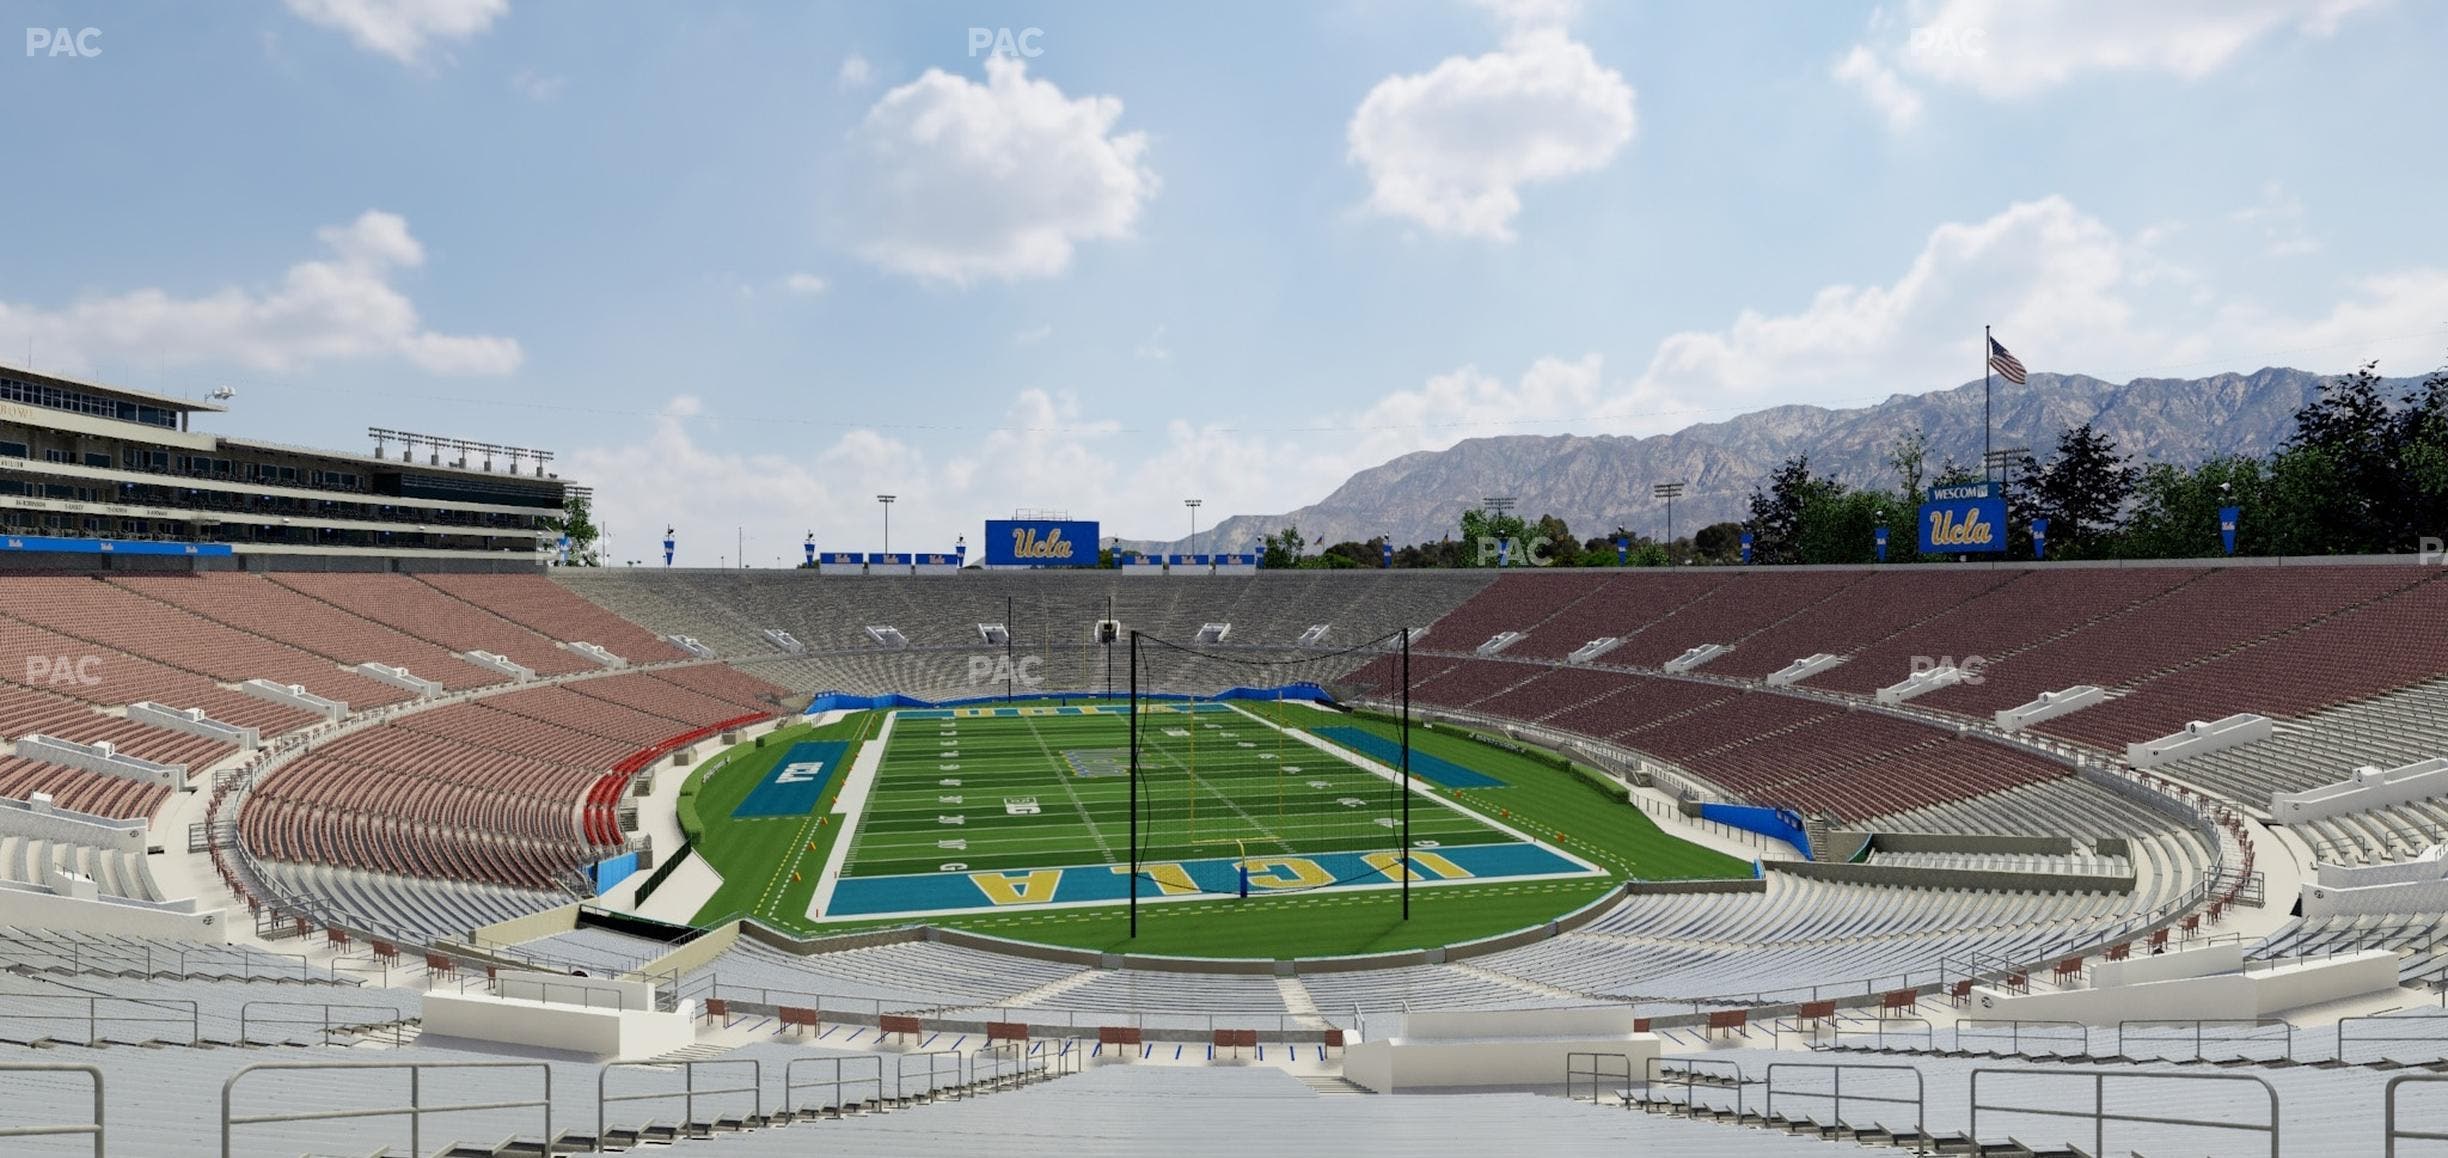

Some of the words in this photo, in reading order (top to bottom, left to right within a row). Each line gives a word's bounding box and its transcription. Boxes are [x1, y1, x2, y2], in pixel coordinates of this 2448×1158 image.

[1934, 486, 1977, 499] WESCOM
[1930, 508, 1993, 546] Ucla
[1012, 528, 1072, 559] Ucla
